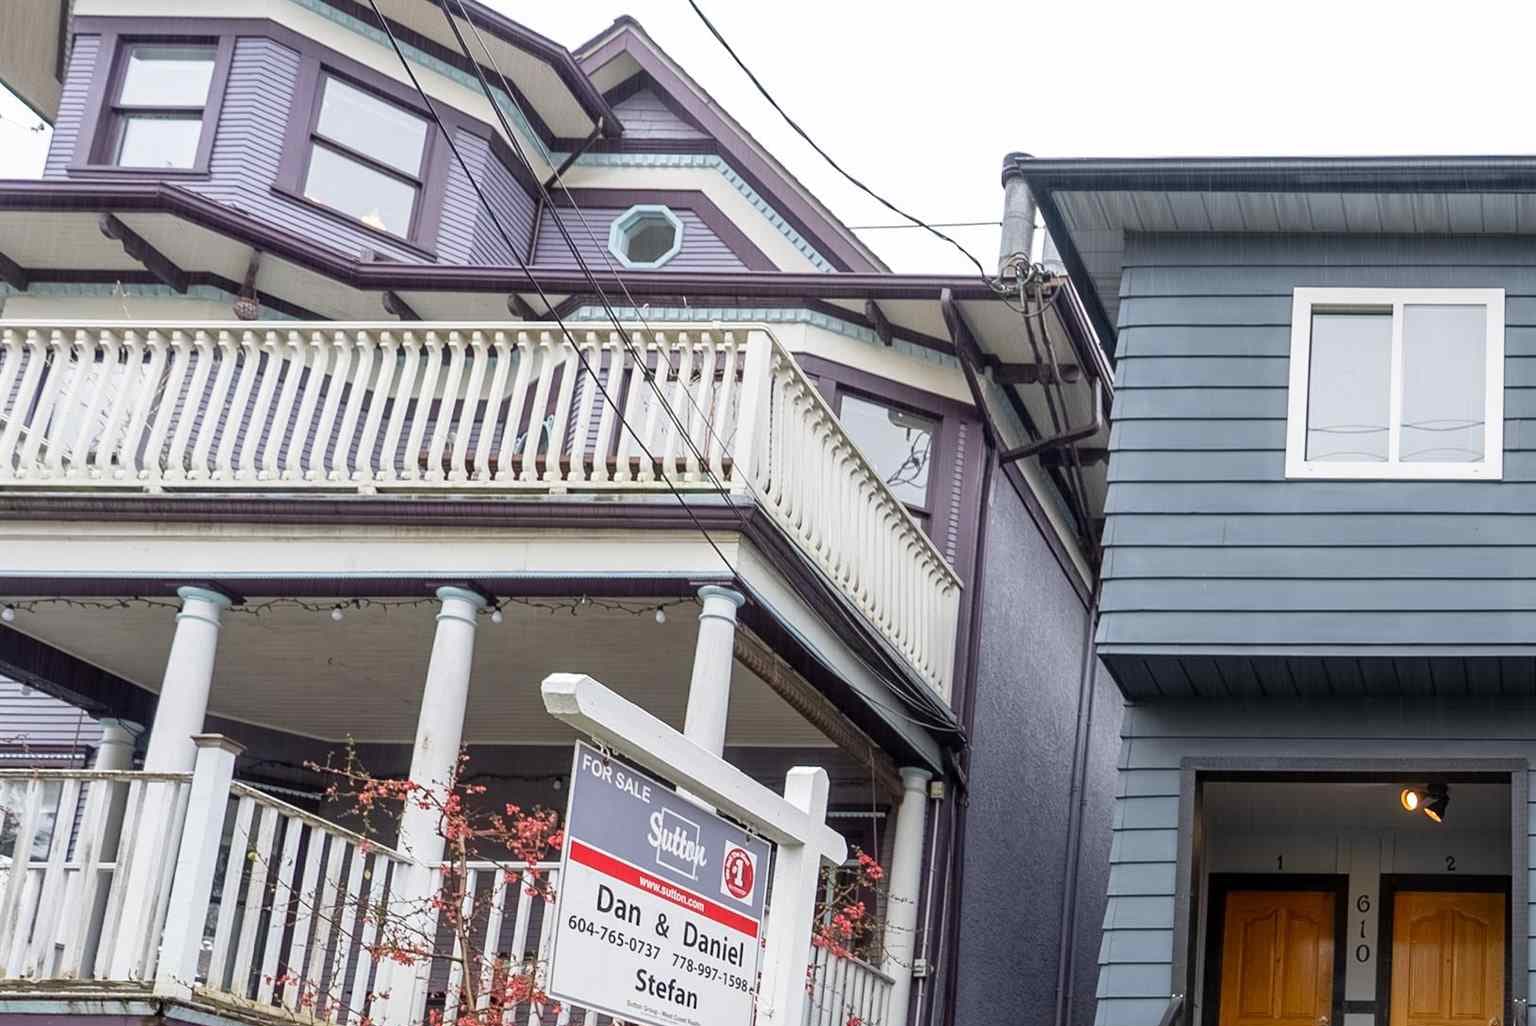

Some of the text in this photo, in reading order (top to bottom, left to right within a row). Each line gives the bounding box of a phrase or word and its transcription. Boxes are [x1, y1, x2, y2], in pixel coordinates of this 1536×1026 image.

[582, 753, 652, 804] FOR SALE
[648, 811, 707, 867] Sutton
[1277, 855, 1283, 871] 1
[1446, 856, 1457, 872] 2
[639, 875, 705, 913] www.sutton.com
[596, 883, 744, 968] Dan & Daniel
[568, 915, 661, 960] 604-765-0737
[672, 953, 748, 993] 778-997-1598
[634, 968, 698, 1010] Stefan
